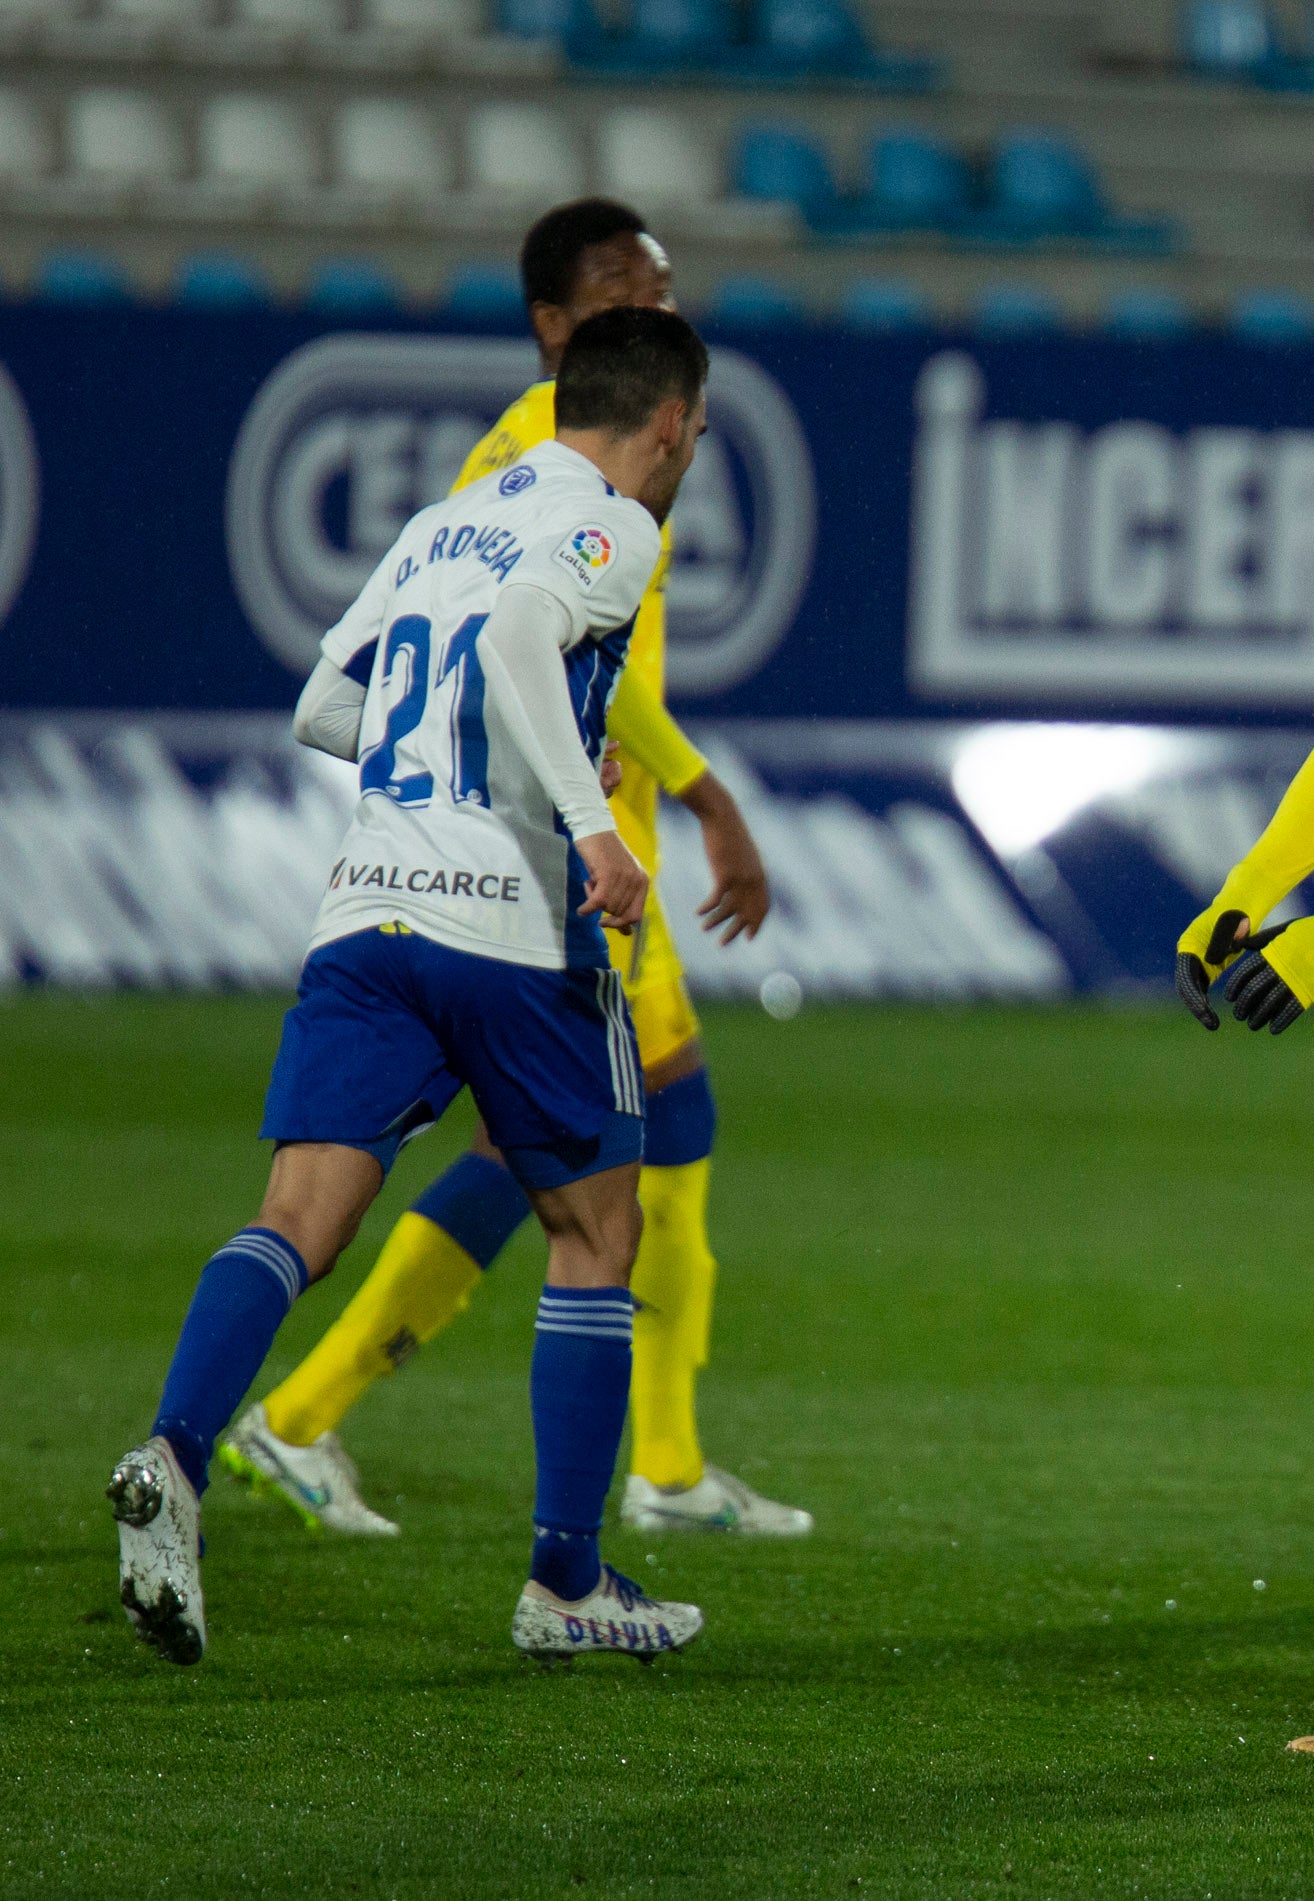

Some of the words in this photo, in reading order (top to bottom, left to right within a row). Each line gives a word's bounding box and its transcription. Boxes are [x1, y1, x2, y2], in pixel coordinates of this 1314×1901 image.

[559, 551, 591, 585] LaLiga
[360, 612, 491, 811] 21
[348, 864, 521, 902] VALCARCE
[565, 1615, 675, 1650] OLIVIA
